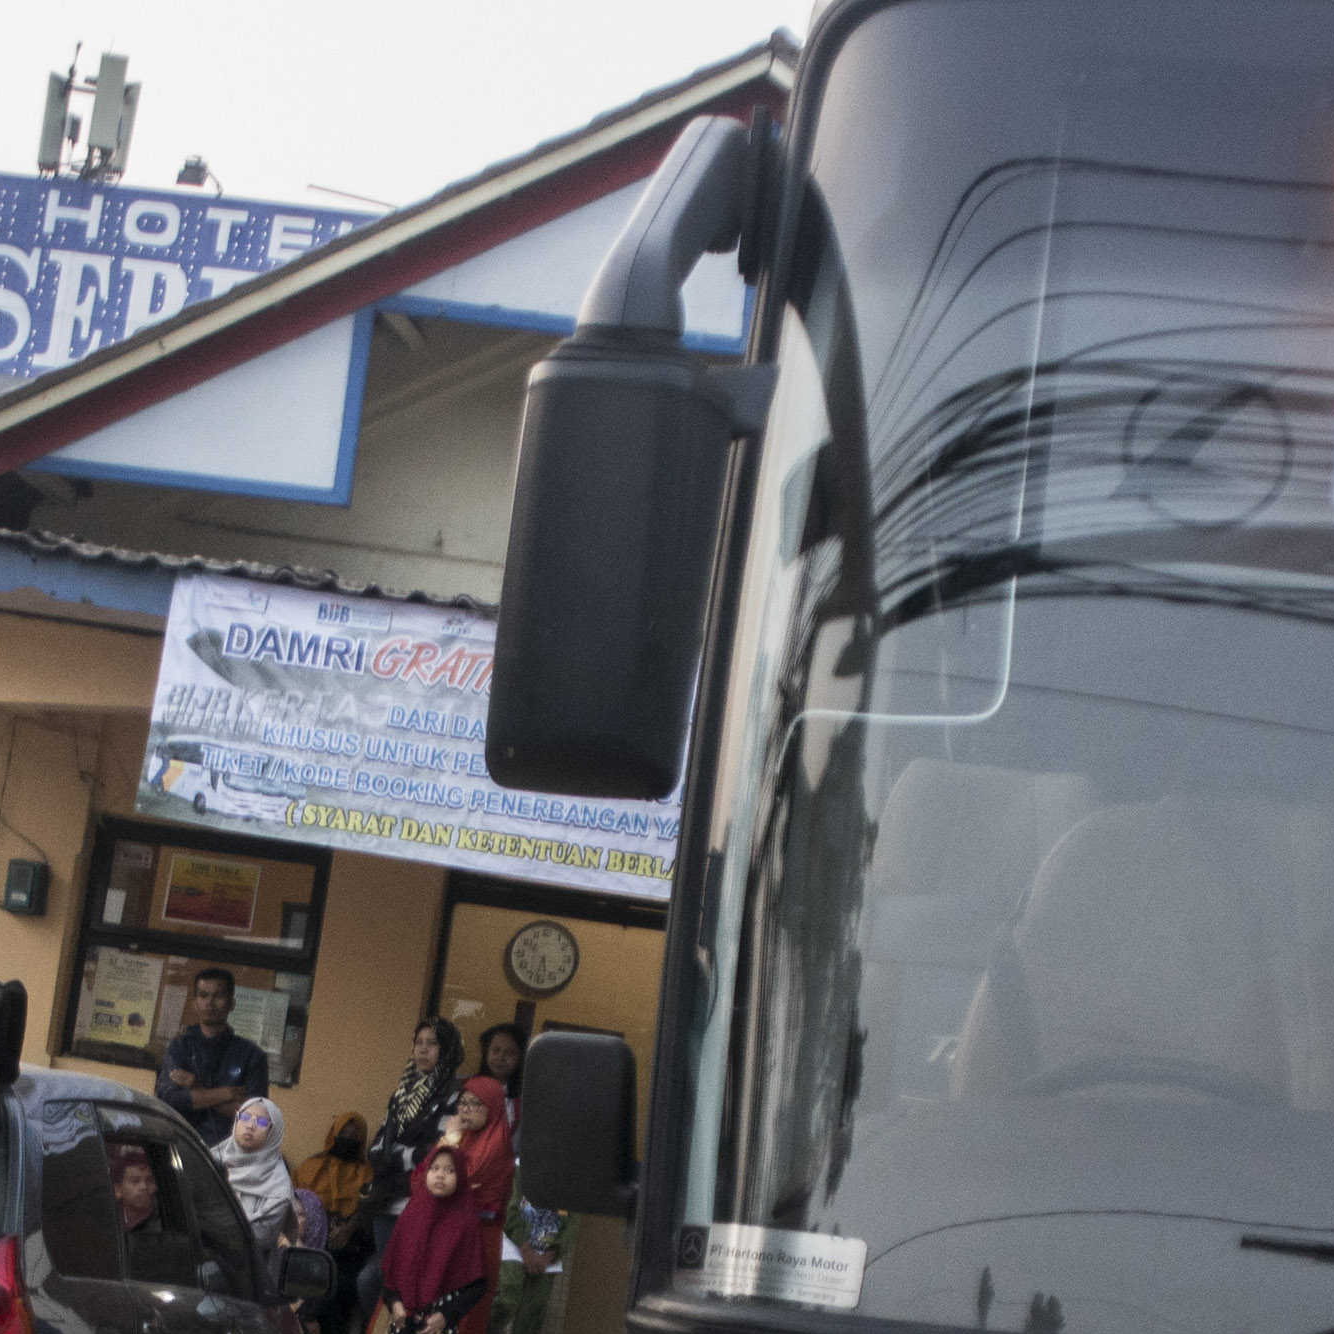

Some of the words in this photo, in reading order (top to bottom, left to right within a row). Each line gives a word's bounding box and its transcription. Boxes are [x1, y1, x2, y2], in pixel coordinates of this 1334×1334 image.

[42, 189, 353, 260] HOTE
[224, 623, 365, 672] DAMRI
[372, 637, 493, 690] GRATI
[262, 722, 359, 754] KHUSUS
[365, 735, 447, 769] UNTUK
[452, 751, 489, 776] PE
[389, 705, 447, 735] DARI
[201, 745, 267, 776] TIKET
[284, 760, 349, 789] KODE
[355, 771, 464, 806] BOOKING
[469, 789, 649, 834] PENERBANGAN
[302, 805, 395, 837] SYARAT
[400, 819, 453, 847] DAN
[457, 828, 602, 869] KETENTUAN
[777, 1251, 806, 1267] Raya
[811, 1256, 850, 1272] Motor
